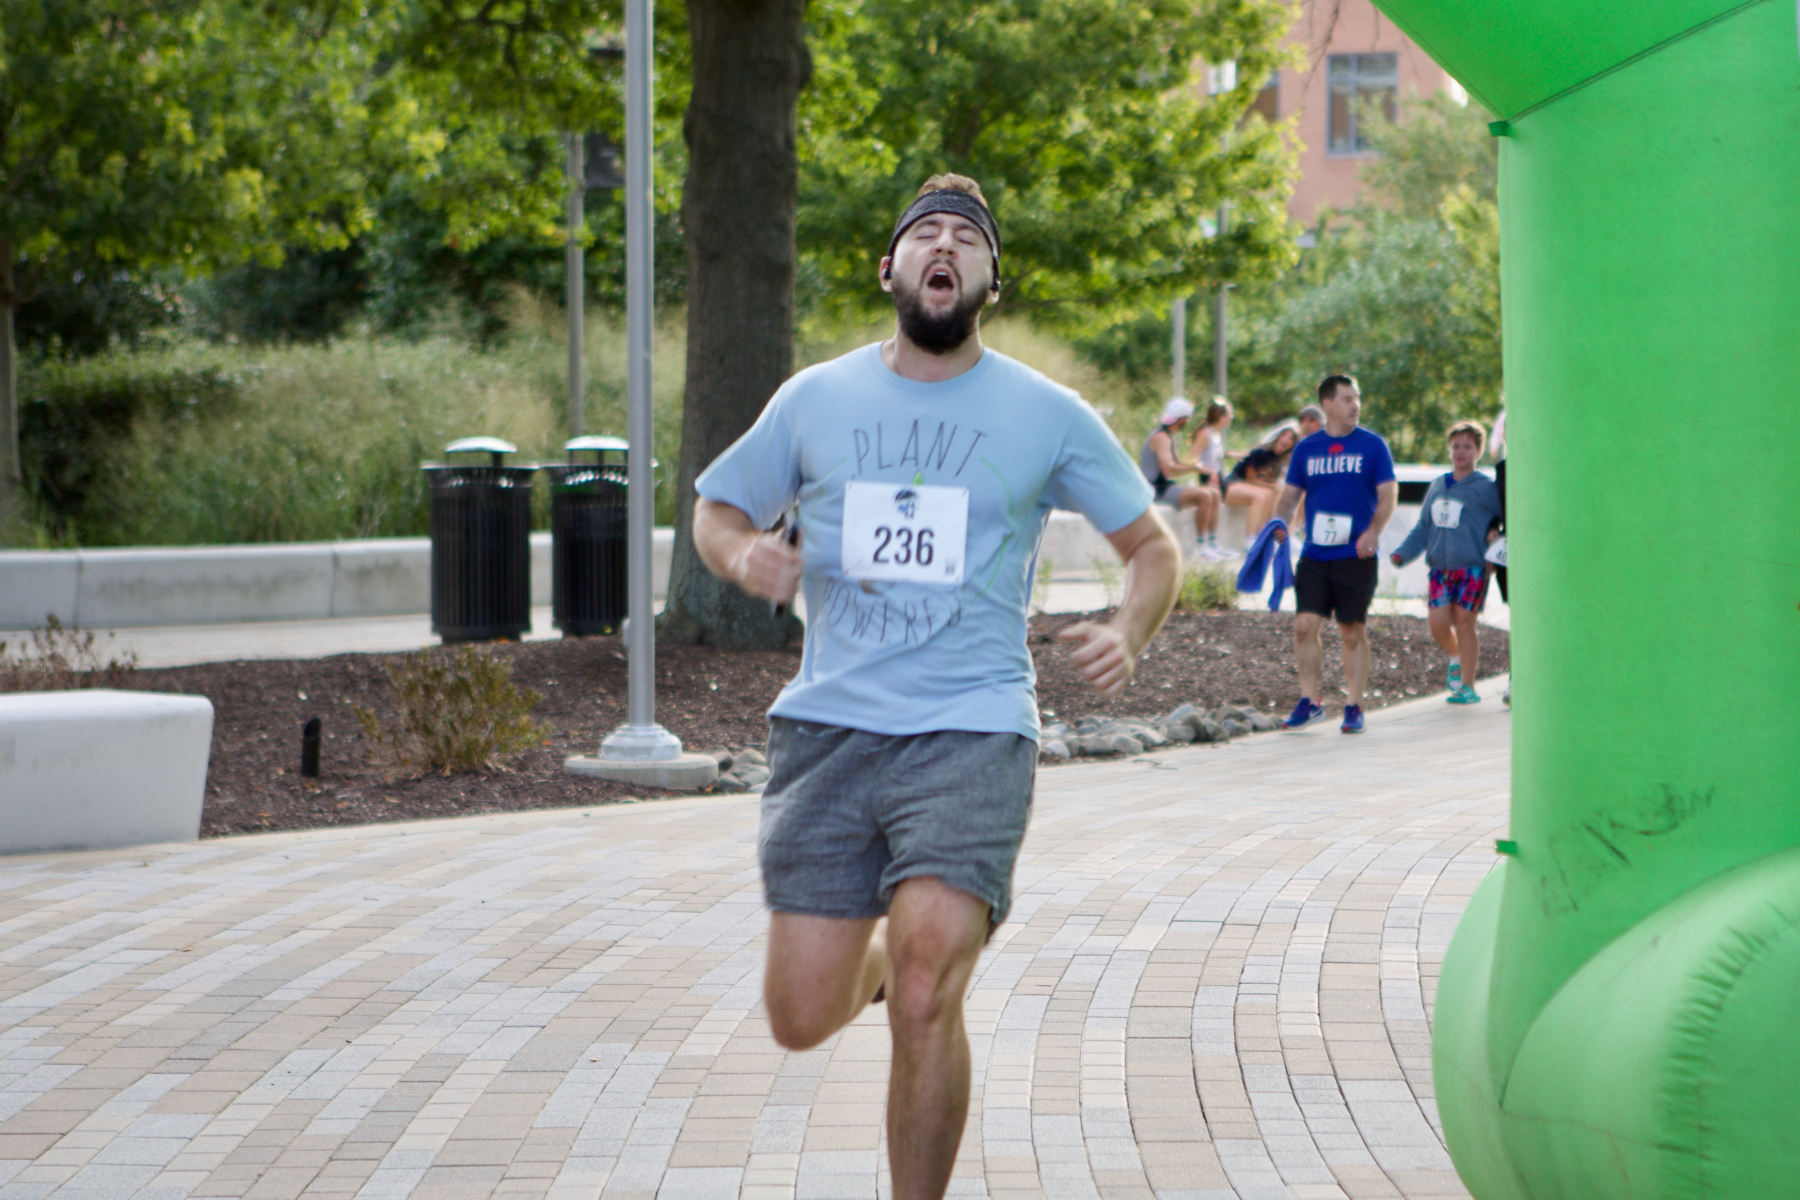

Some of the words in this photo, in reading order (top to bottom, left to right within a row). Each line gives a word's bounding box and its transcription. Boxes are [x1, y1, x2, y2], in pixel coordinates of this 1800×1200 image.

[853, 418, 987, 478] PLANT
[1307, 455, 1363, 476] BILLIEVE
[872, 524, 935, 566] 236
[1324, 530, 1337, 544] 77
